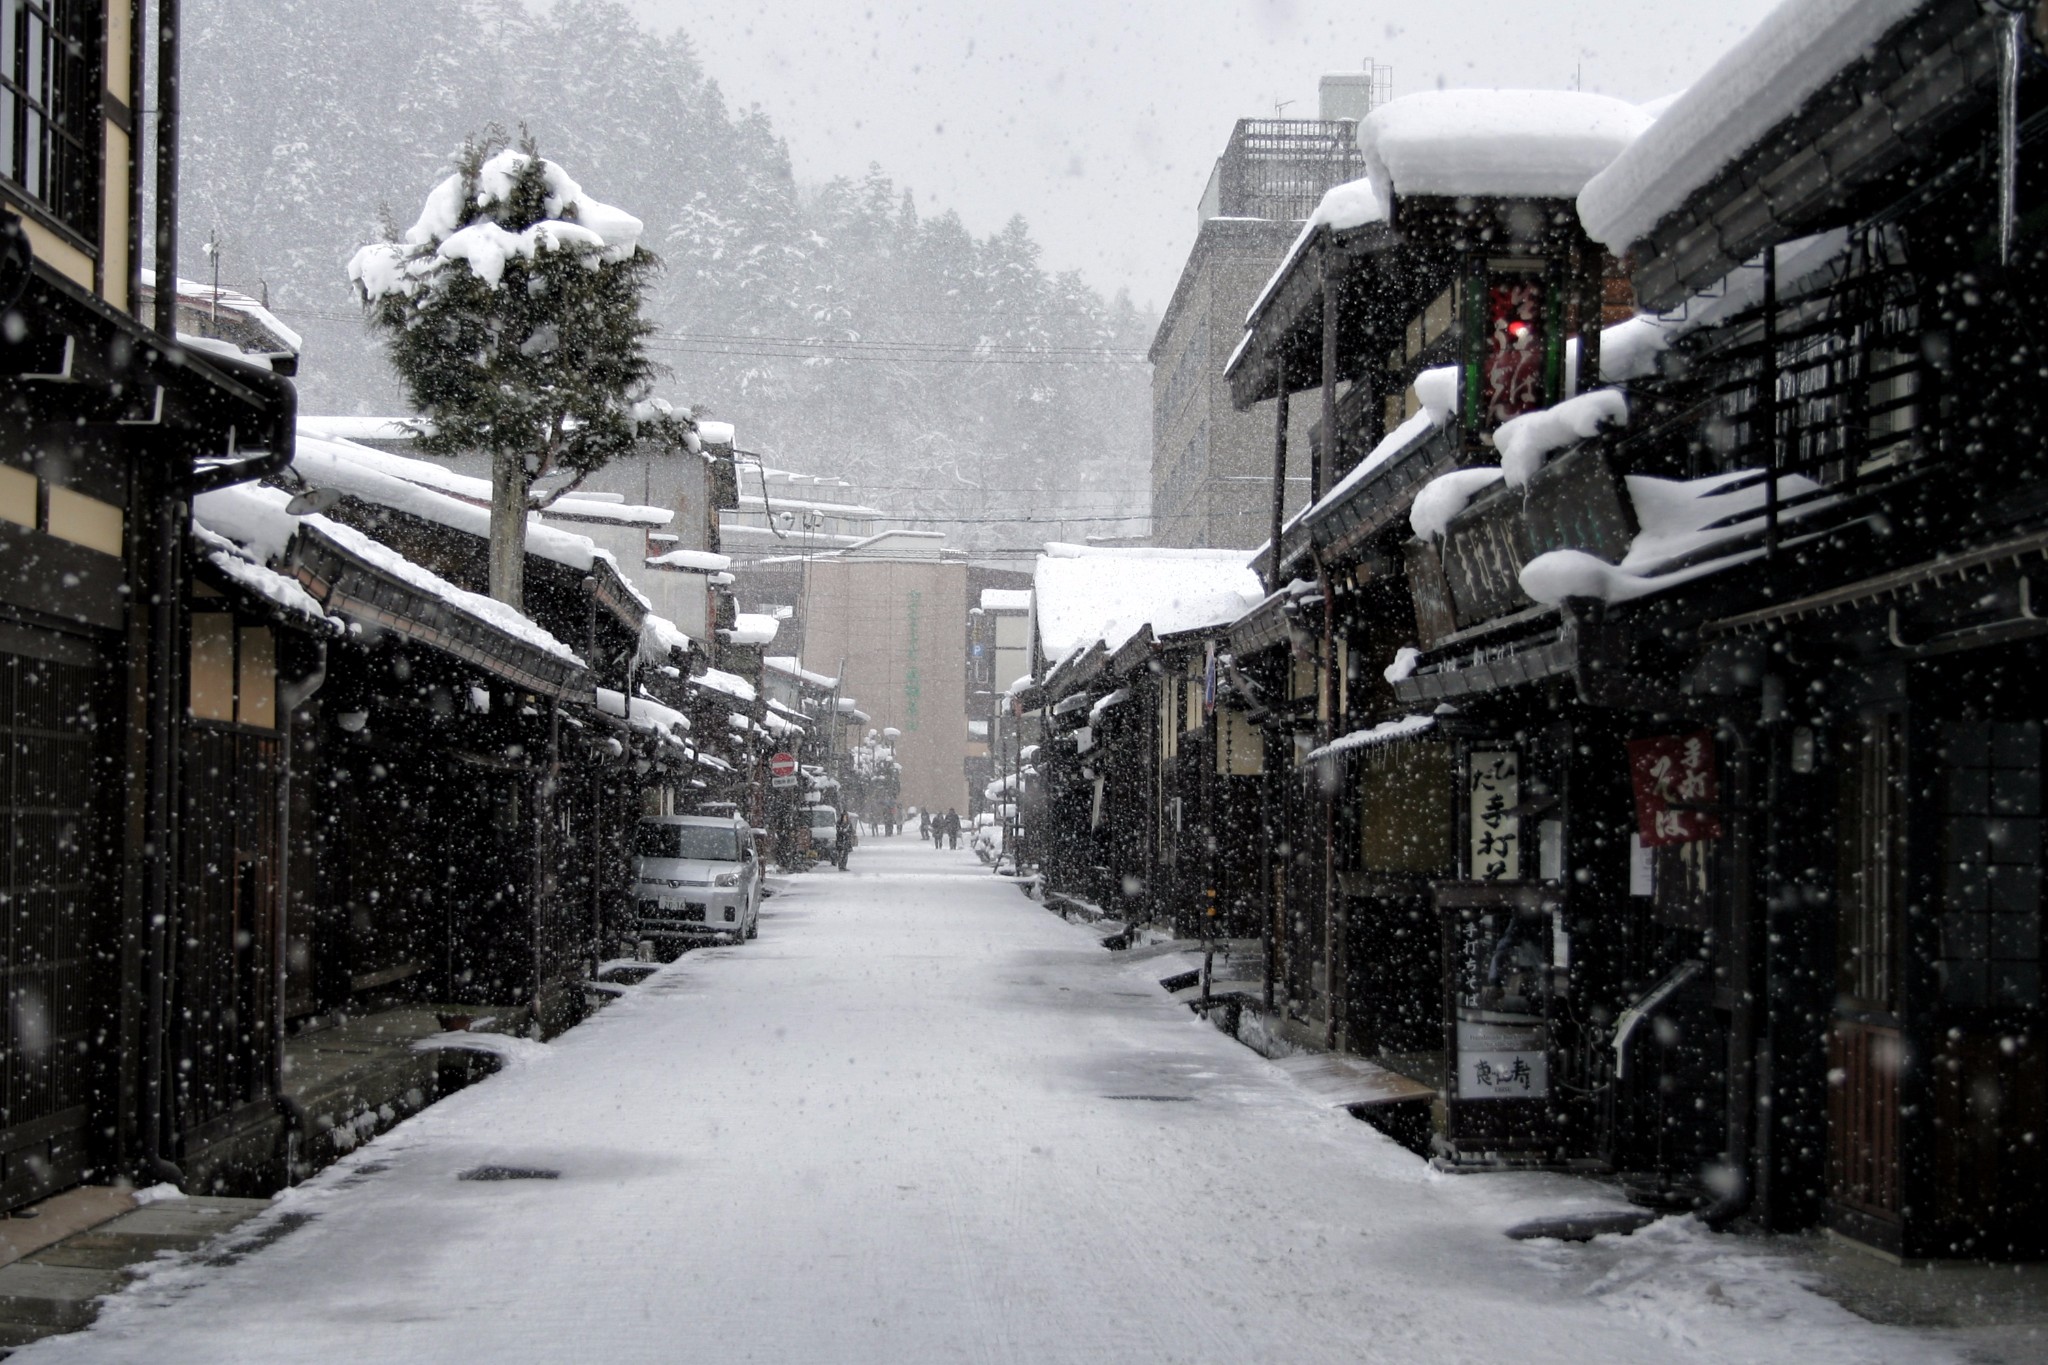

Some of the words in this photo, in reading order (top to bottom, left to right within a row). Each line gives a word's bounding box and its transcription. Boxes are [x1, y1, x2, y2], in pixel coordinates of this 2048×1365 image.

[974, 645, 981, 656] P
[1462, 921, 1479, 1007] 手打ちそば
